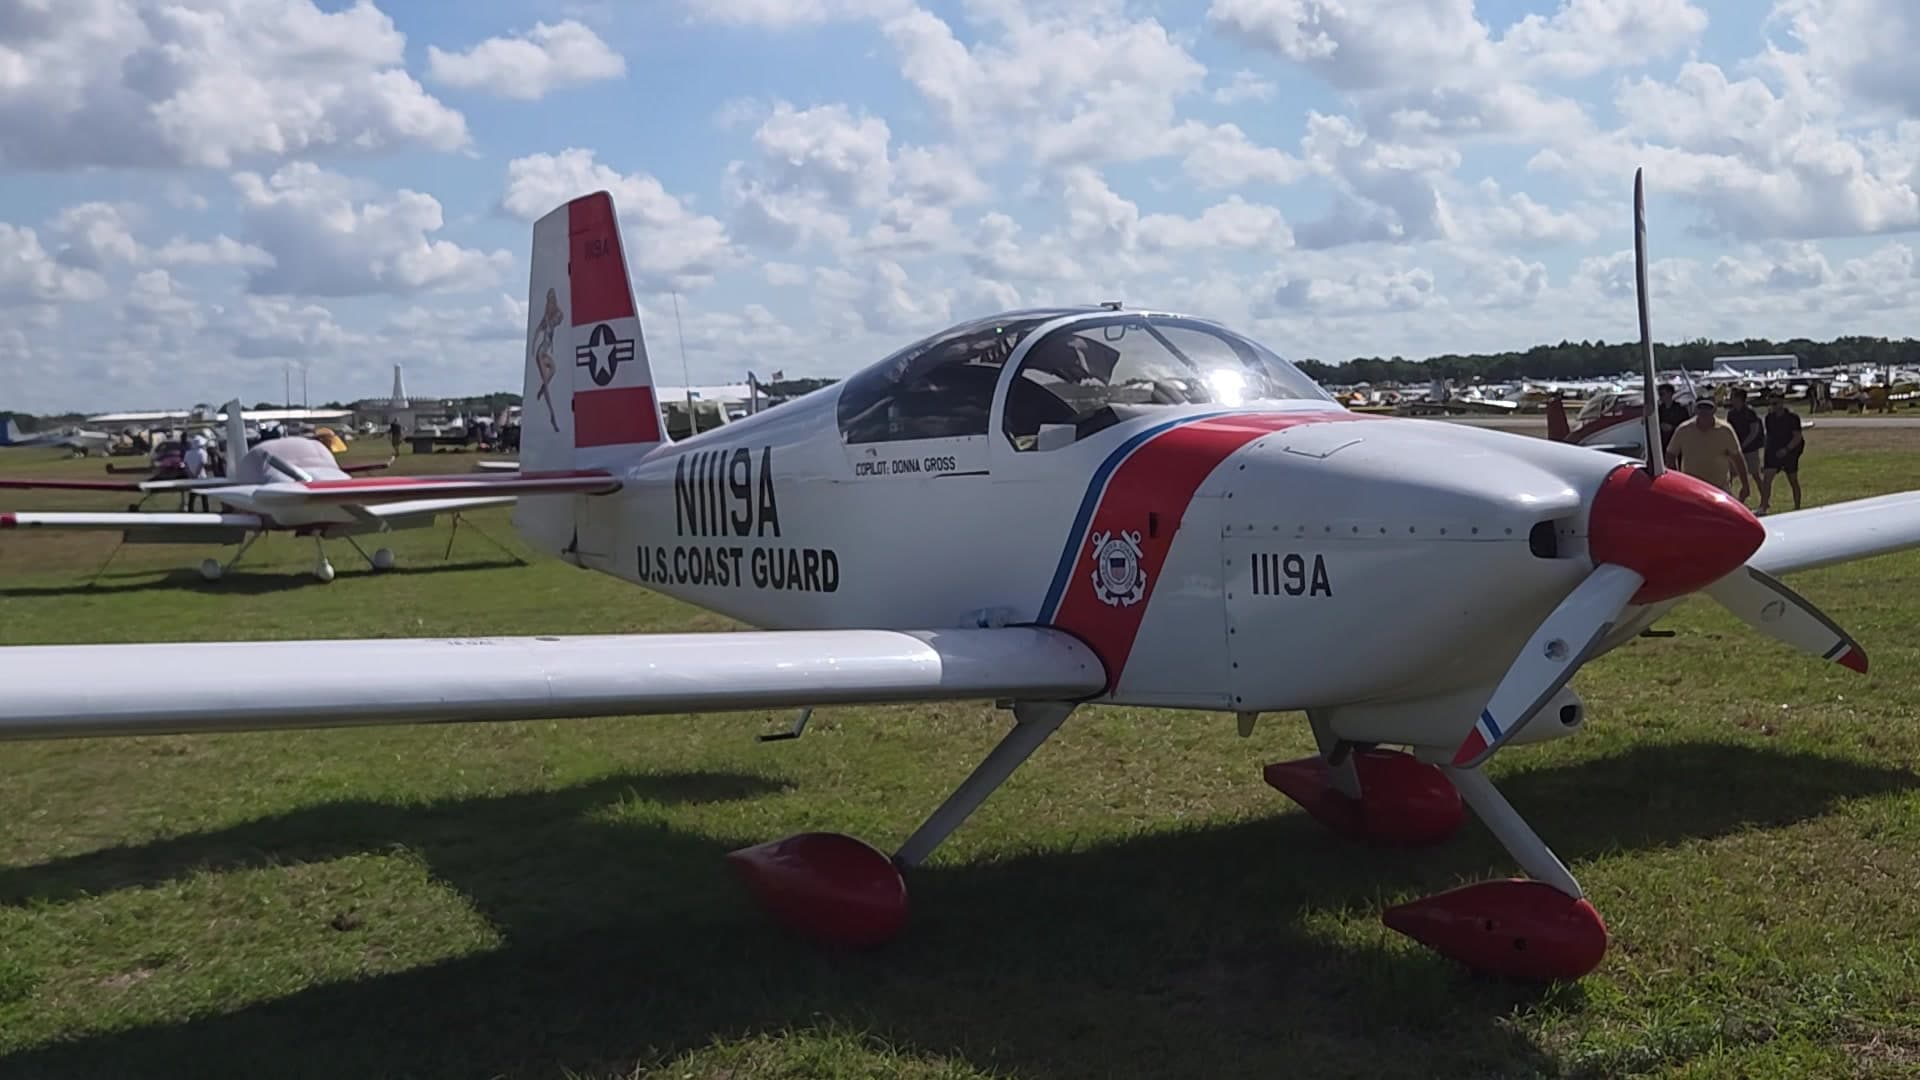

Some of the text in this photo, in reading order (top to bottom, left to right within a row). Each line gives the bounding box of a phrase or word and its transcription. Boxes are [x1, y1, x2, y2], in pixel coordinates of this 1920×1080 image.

[856, 456, 956, 476] COPILOT: DONNA GROSS
[675, 446, 780, 537] N1119A
[752, 547, 839, 592] GUARD
[1252, 553, 1332, 597] 1119A
